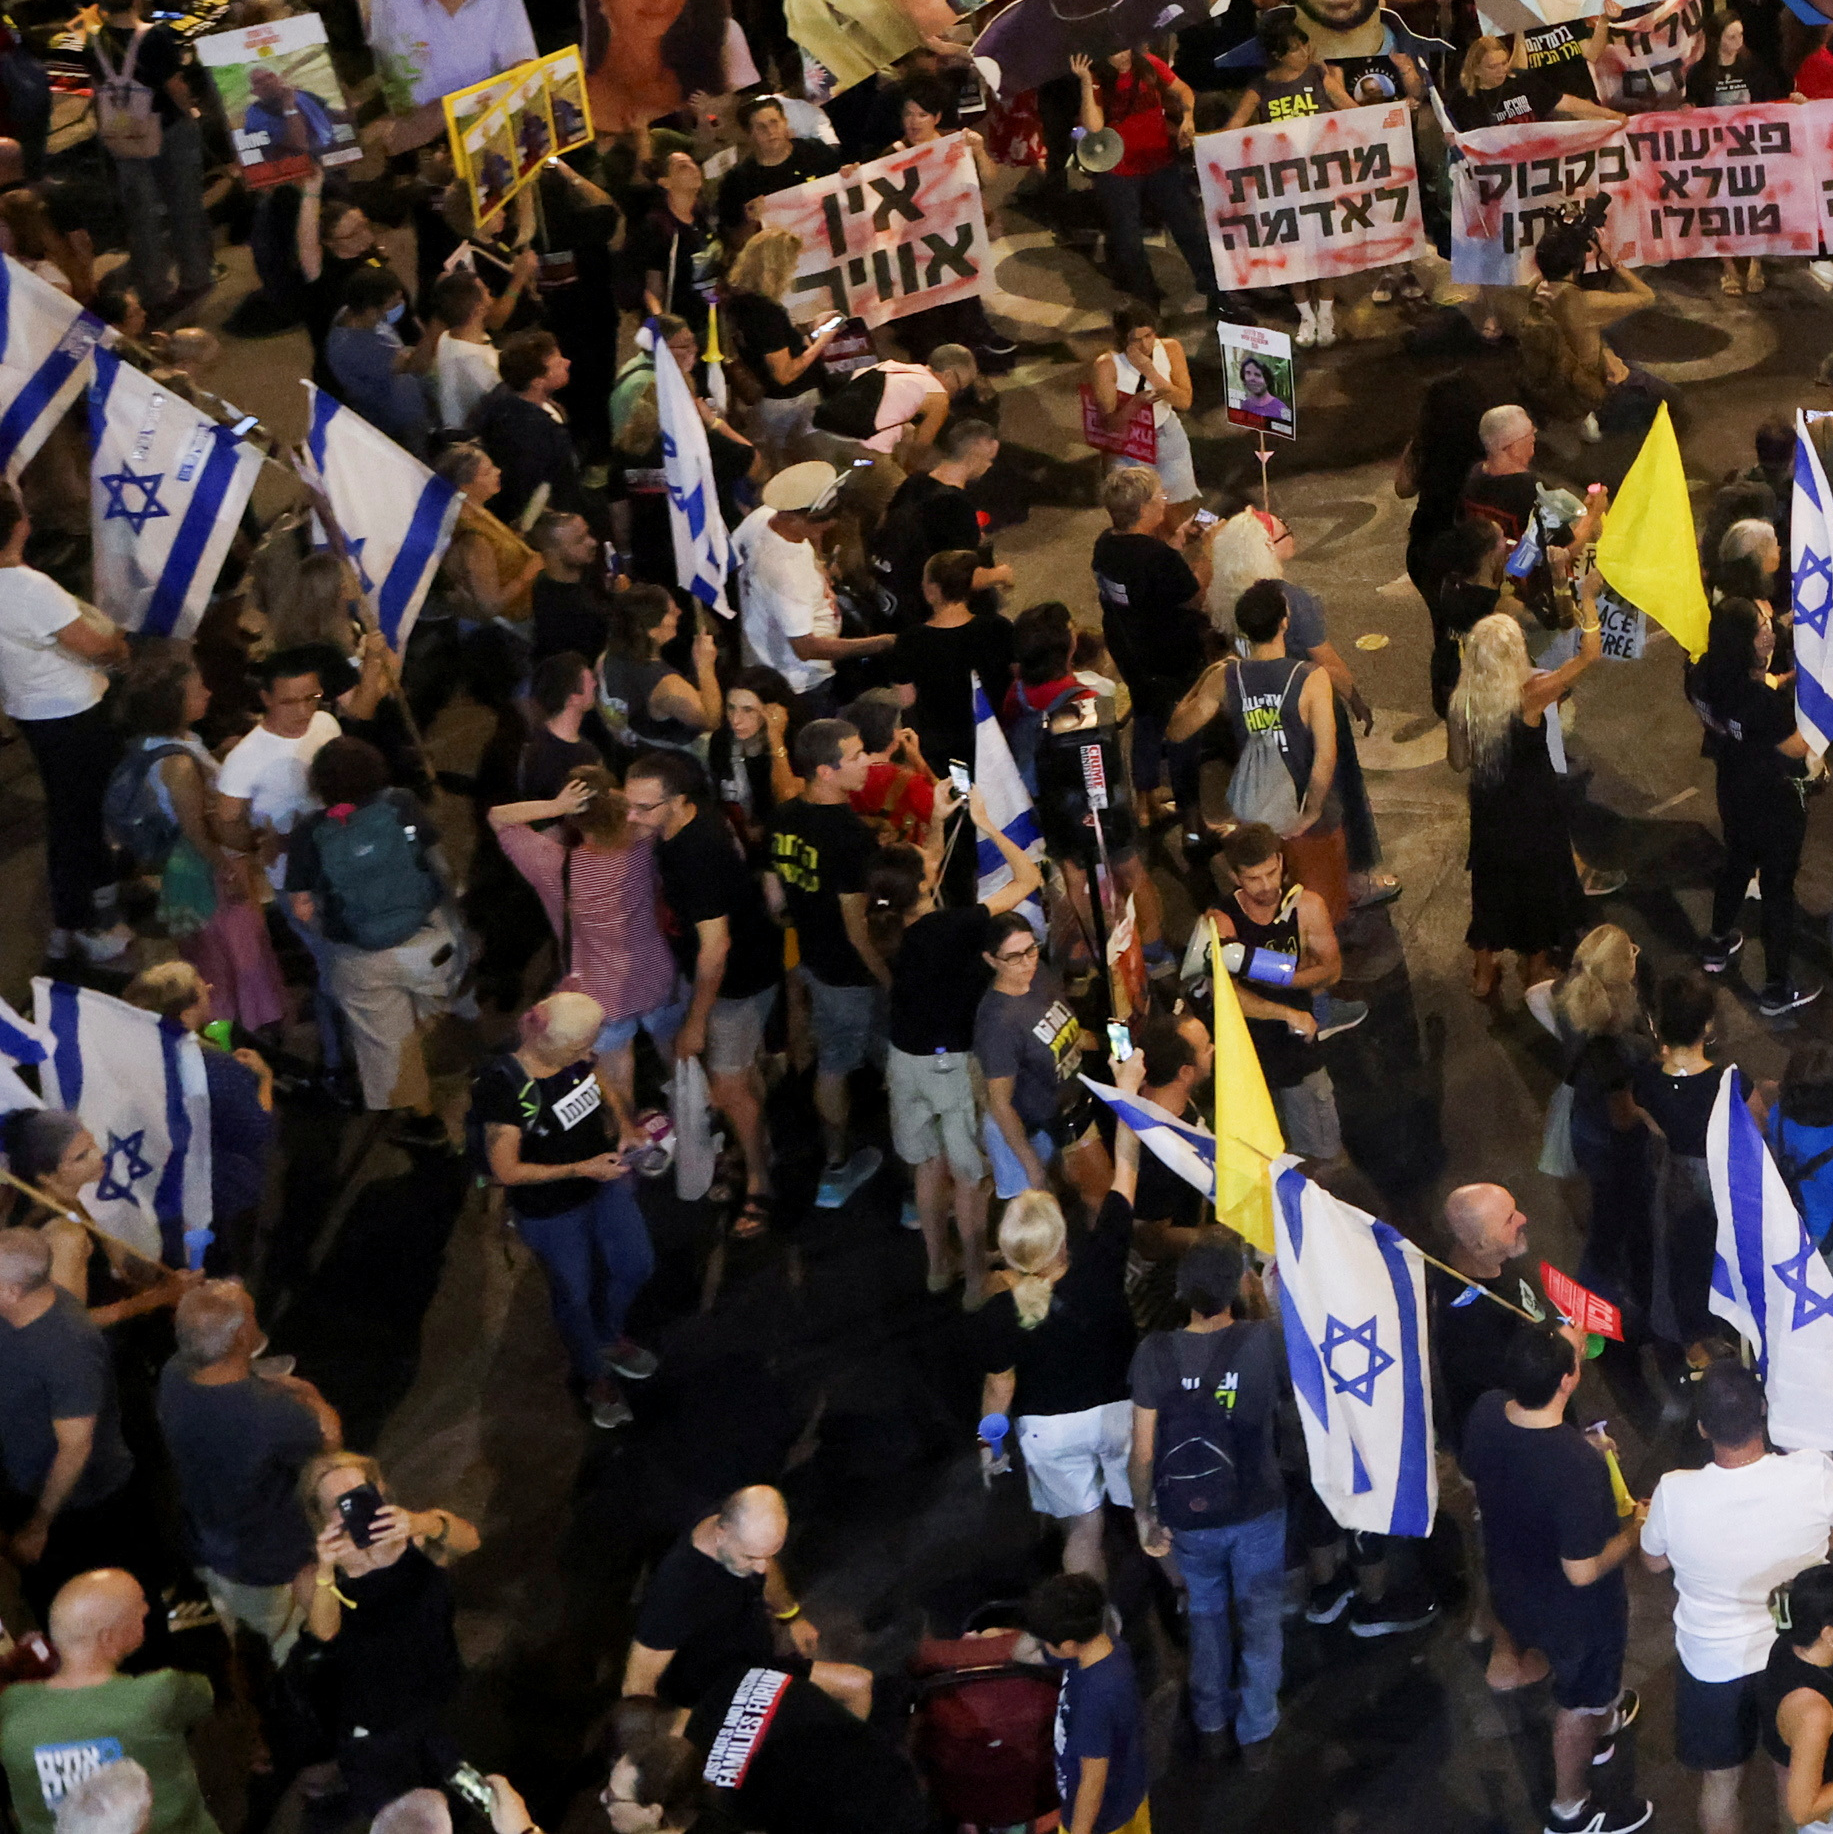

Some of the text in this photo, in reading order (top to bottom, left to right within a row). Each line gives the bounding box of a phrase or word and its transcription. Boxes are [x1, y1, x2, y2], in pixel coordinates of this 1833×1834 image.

[1268, 93, 1319, 117] SEAL
[1225, 142, 1393, 205] מתחת
[1474, 145, 1631, 205] בקבוק
[1659, 164, 1766, 201] שלא
[823, 166, 925, 259] אין
[1218, 186, 1410, 251] לאדמה
[1651, 204, 1781, 240] טופלו
[791, 222, 979, 318] אוויר
[1089, 746, 1104, 789] CRIME
[716, 1669, 789, 1788] FAMILIES FORUM
